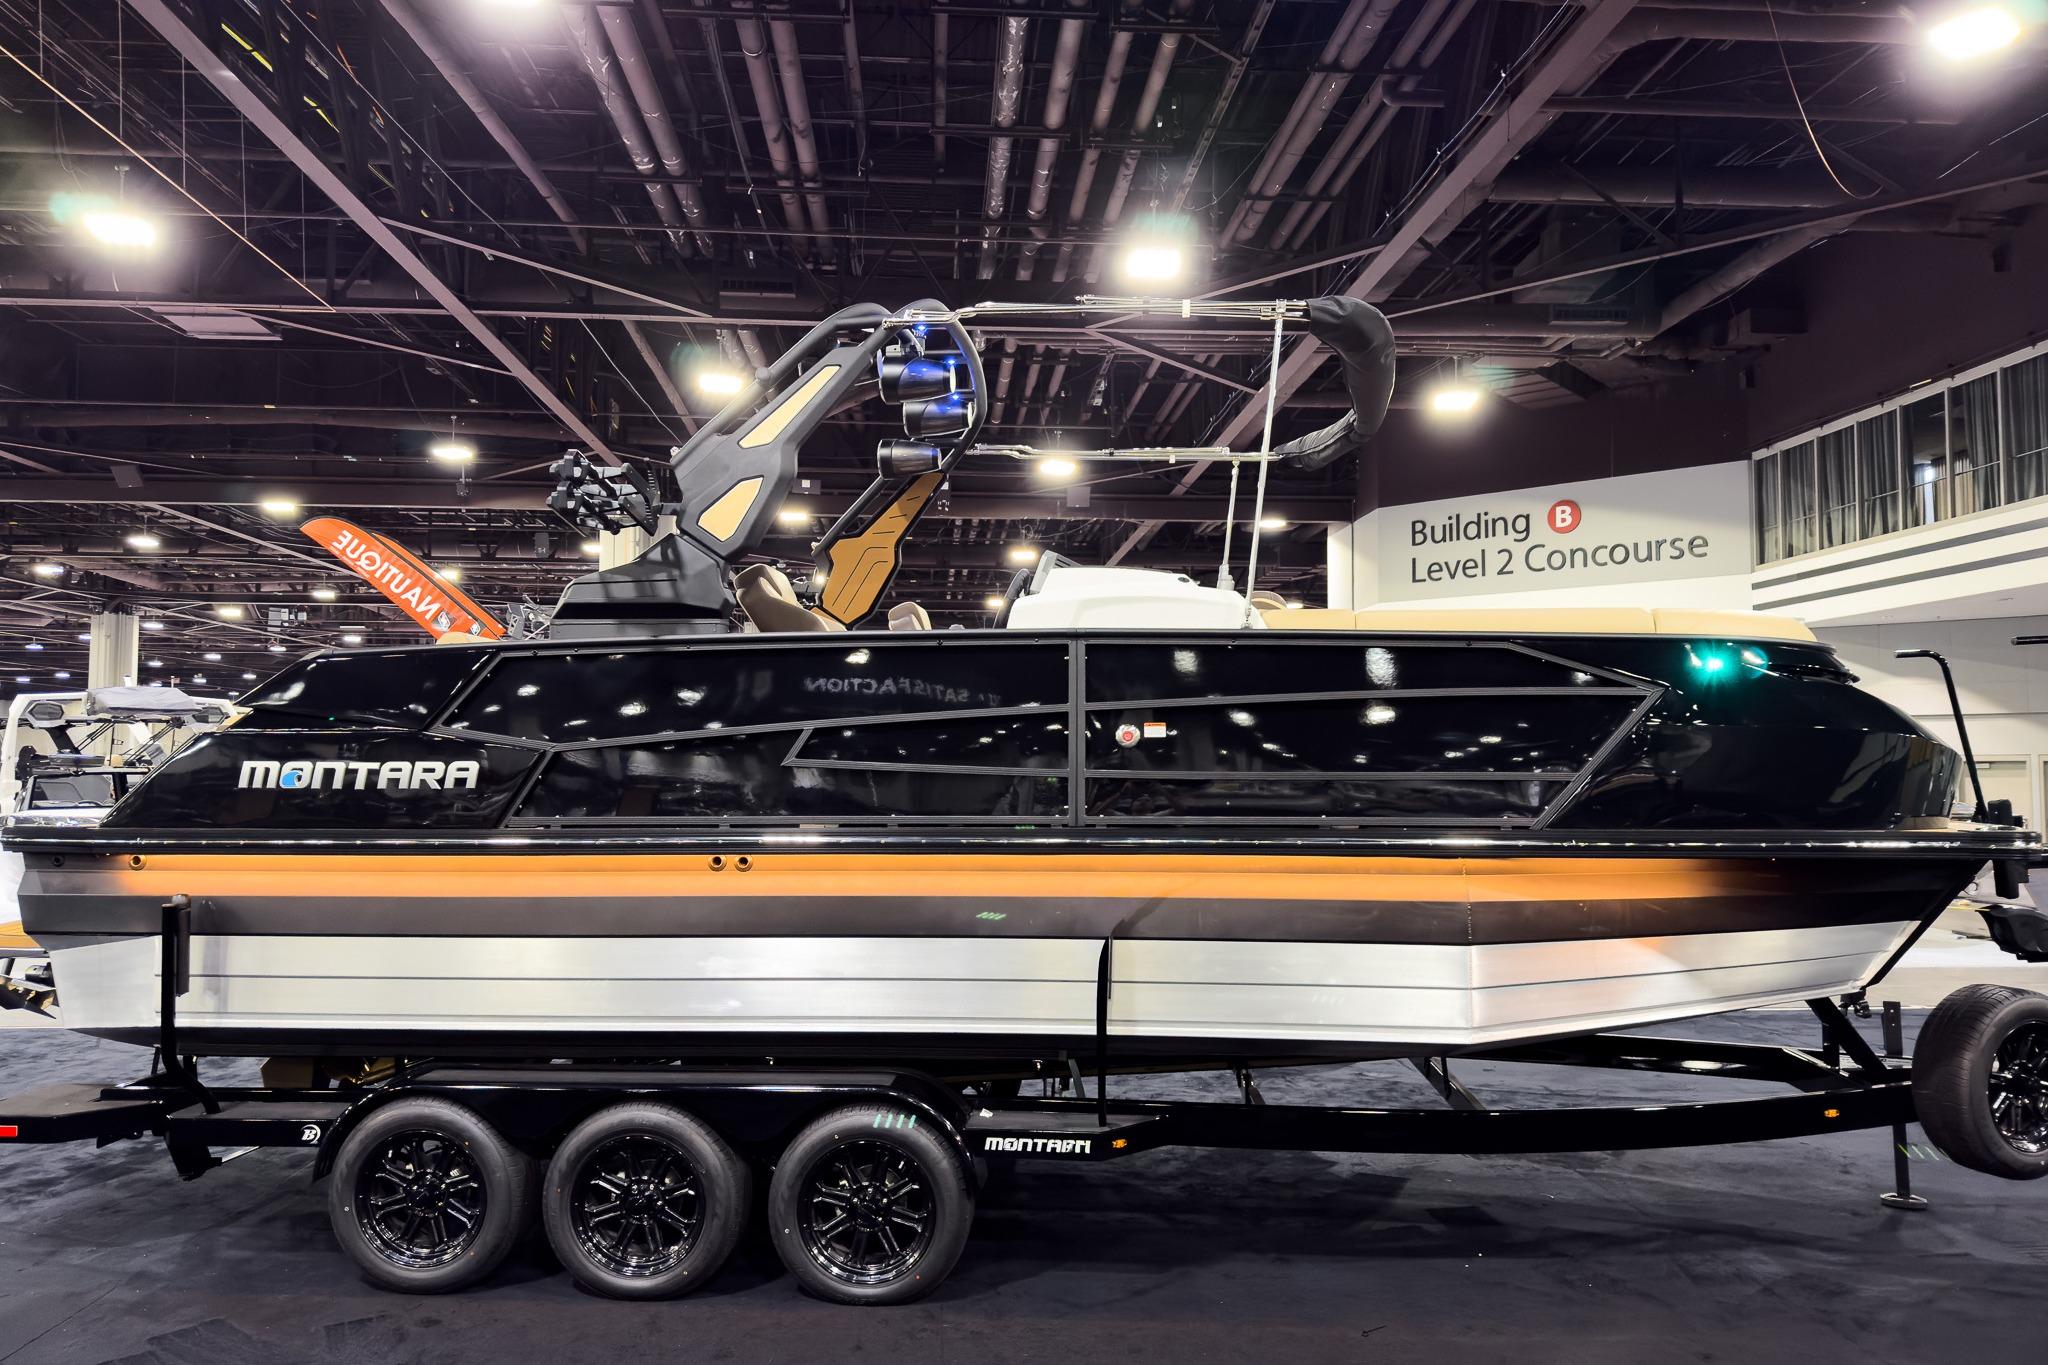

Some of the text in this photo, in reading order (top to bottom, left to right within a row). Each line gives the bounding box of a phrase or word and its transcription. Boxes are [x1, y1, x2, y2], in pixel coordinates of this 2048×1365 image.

[1411, 505, 1574, 547] Building B
[1411, 534, 1709, 583] Level 2 Concourse
[238, 760, 480, 790] MONTARA
